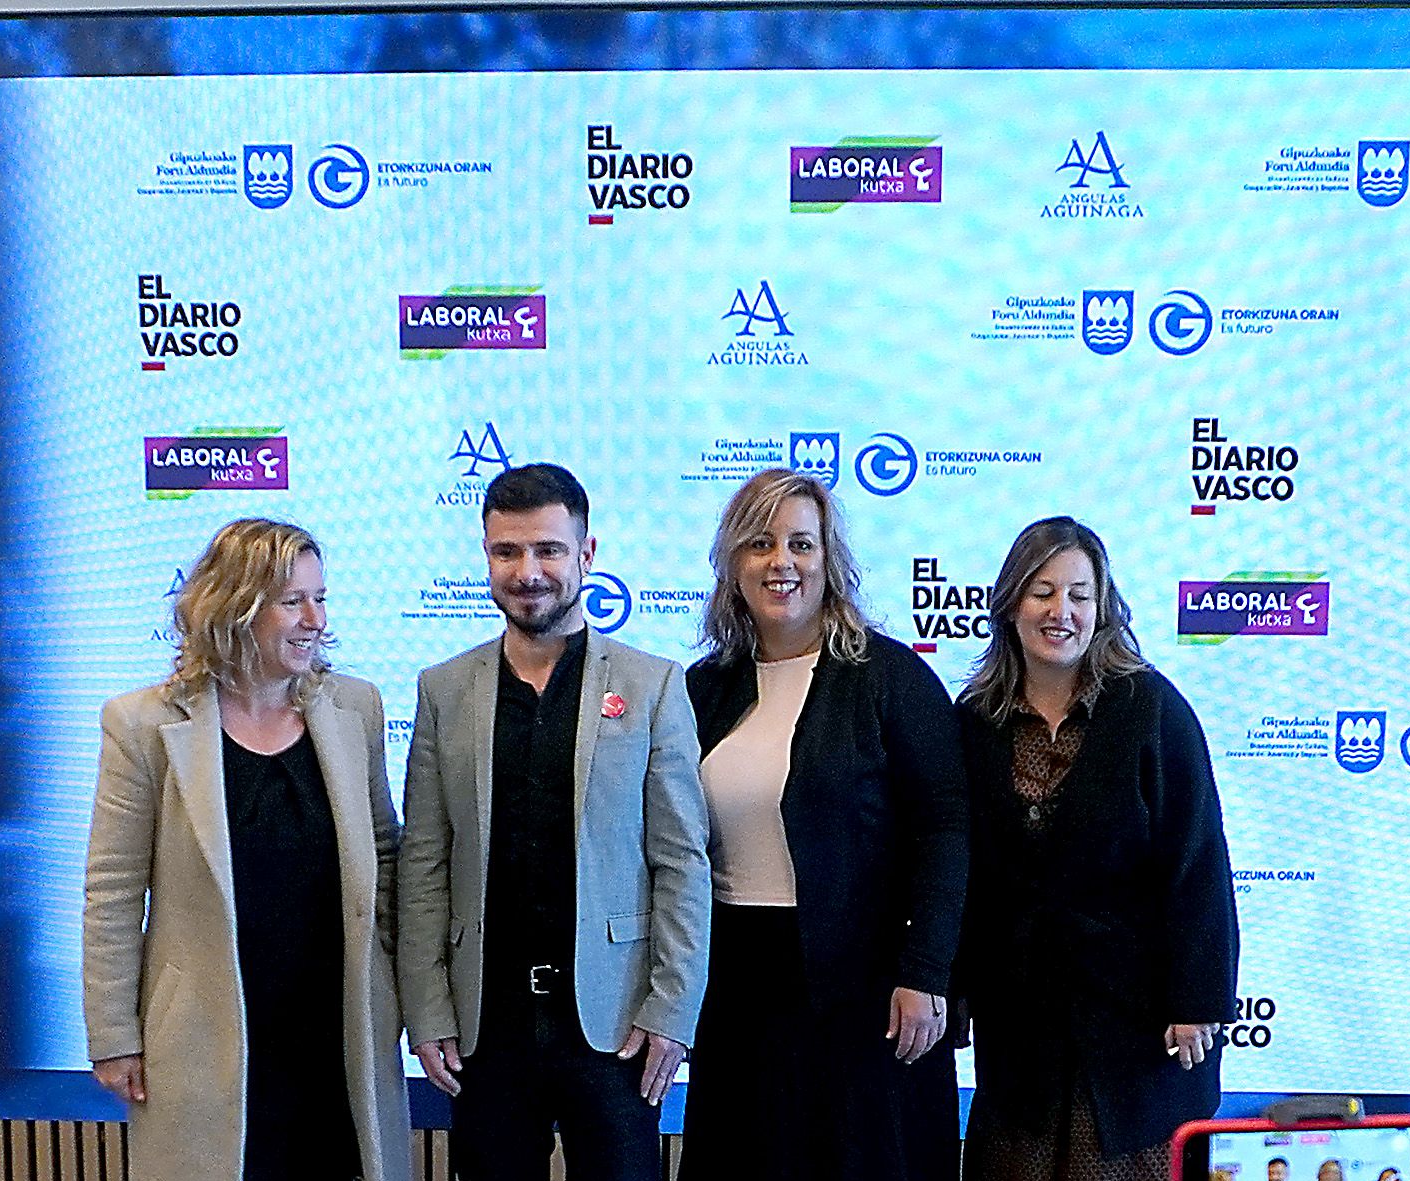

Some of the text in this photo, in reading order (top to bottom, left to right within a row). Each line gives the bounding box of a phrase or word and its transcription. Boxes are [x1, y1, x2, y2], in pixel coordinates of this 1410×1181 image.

[588, 125, 622, 150] EL
[157, 166, 183, 175] Foru
[378, 163, 491, 173] ETORKIZUNA ORAIN
[588, 153, 692, 179] DIARIO
[799, 158, 904, 177] LABORAL
[1266, 162, 1293, 171] Foru
[393, 176, 428, 187] futuro
[861, 180, 904, 193] kutxa
[588, 184, 689, 209] VASCO
[1061, 194, 1125, 206] ANGULAS
[1041, 205, 1143, 217] AGUINAGA
[138, 275, 171, 299] EL
[139, 302, 241, 327] DIARIO
[407, 307, 510, 326] LABORAL
[993, 310, 1019, 319] Foru
[1222, 309, 1339, 320] ETORKIZUNA ORAIN
[467, 325, 510, 341] kutxa
[1237, 323, 1273, 334] futuro
[141, 332, 238, 356] VASCO
[727, 342, 792, 354] ANGULAS
[708, 353, 808, 365] AGUINAGA
[1193, 418, 1227, 442] EL
[153, 449, 252, 466] LABORAL
[702, 450, 728, 461] Foru
[926, 452, 1041, 462] ETORKIZUNA ORAIN
[1192, 446, 1298, 471] DIARIO
[212, 469, 253, 481] kutxa
[941, 465, 976, 476] futuro
[1193, 475, 1293, 501] VASCO
[913, 558, 947, 582] EL
[421, 590, 447, 600] Foru
[640, 591, 707, 602] ETORKIZUN
[1187, 593, 1291, 610] LABORAL
[655, 604, 689, 614] futuro
[1248, 613, 1291, 626] kutxa
[913, 615, 991, 638] VASC
[1247, 730, 1274, 739] Foru
[1278, 871, 1314, 880] ORAIN
